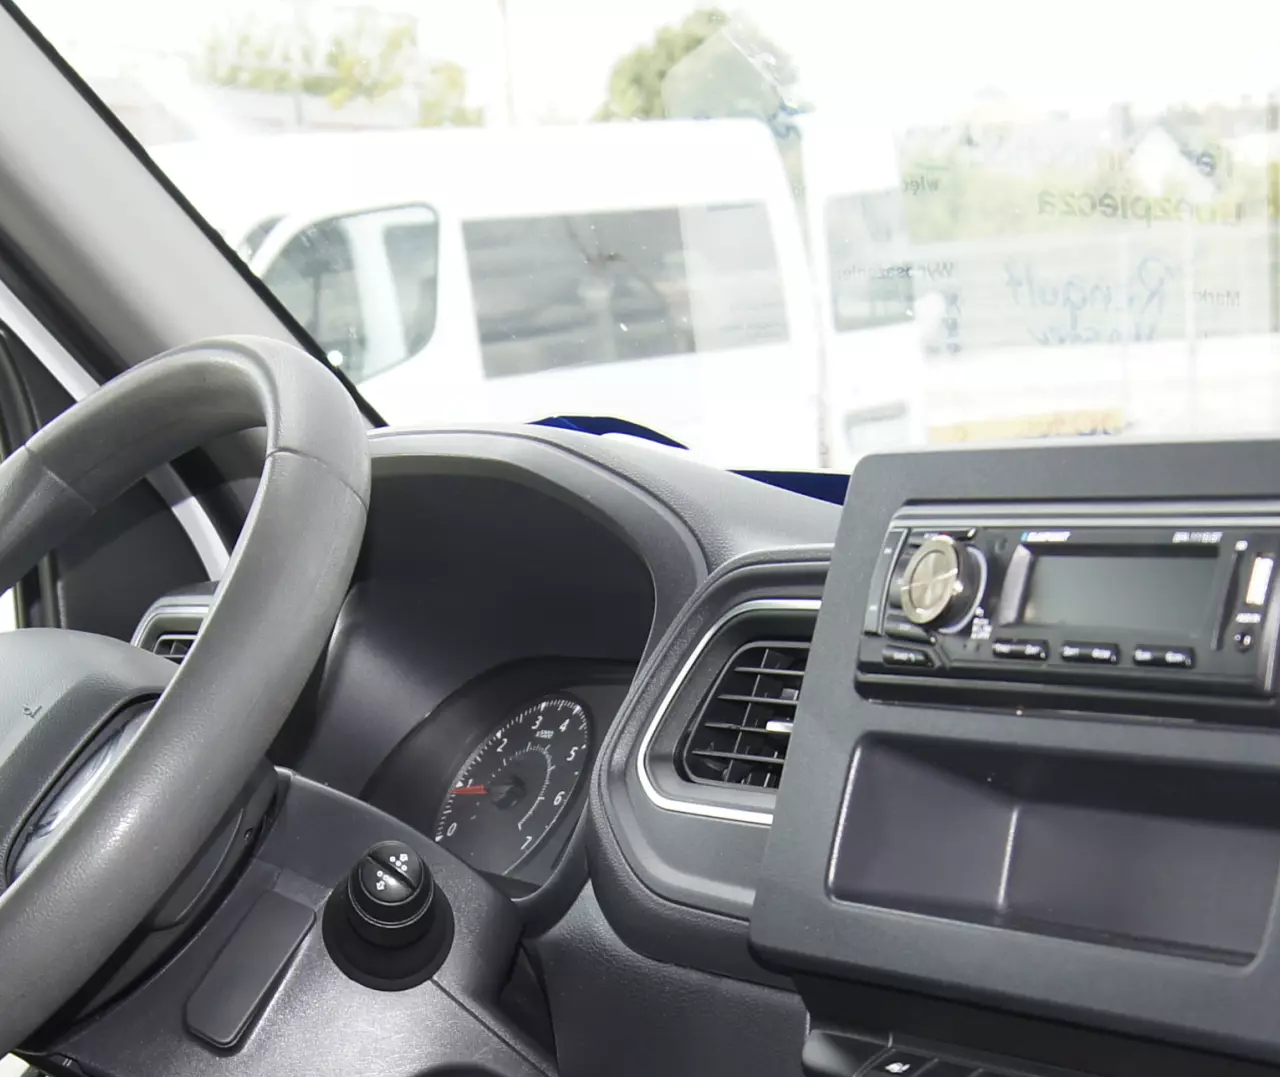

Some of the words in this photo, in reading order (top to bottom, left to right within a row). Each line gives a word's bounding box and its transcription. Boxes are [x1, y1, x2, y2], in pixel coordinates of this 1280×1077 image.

[531, 715, 543, 729] 3
[559, 718, 570, 733] 4
[496, 738, 508, 752] 2
[566, 746, 578, 761] 5
[553, 791, 565, 806] 6
[446, 822, 457, 836] 0
[521, 835, 532, 850] 7
